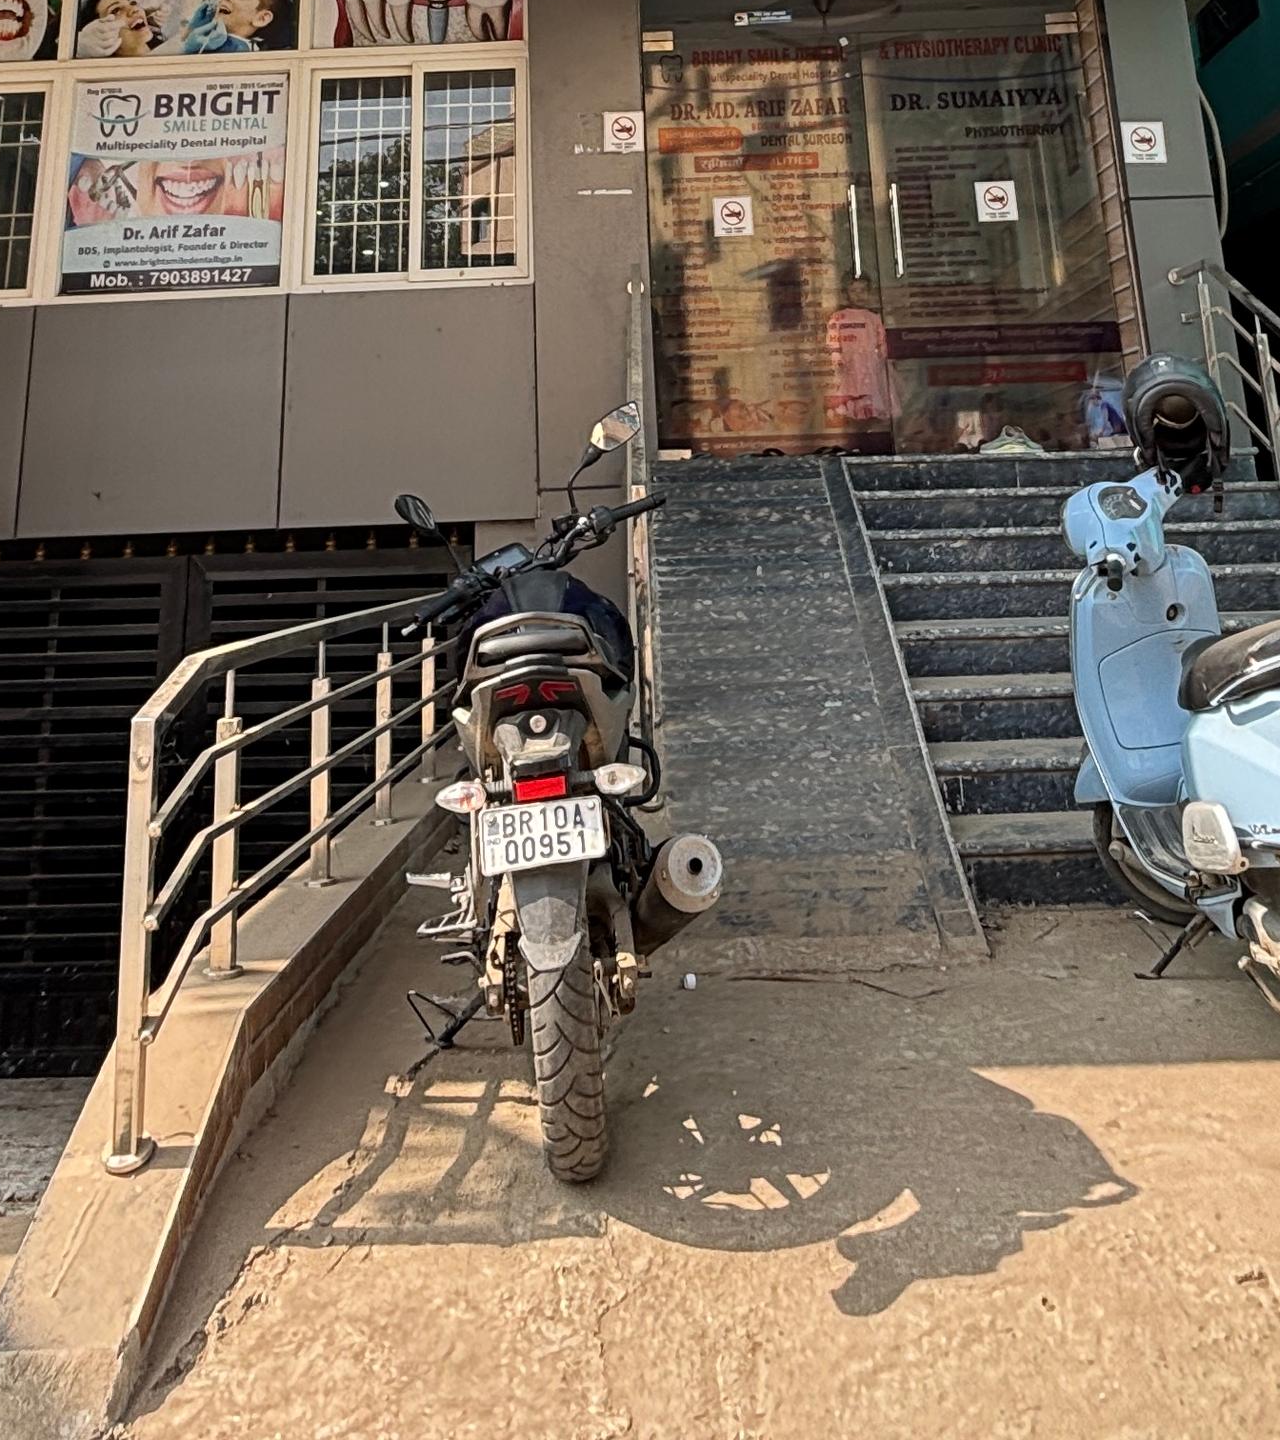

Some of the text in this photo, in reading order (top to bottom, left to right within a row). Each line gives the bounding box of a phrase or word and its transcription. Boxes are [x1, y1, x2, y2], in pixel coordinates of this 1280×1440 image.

[894, 37, 1009, 58] PHYSIOTHERAPY
[1015, 35, 1062, 54] CLINIC
[692, 49, 743, 67] BRIGHT
[747, 47, 795, 66] SMILE
[769, 69, 800, 80] Dental
[153, 90, 281, 118] BRIGHT
[671, 97, 850, 121] DR. MD. ARIF ZAFAR
[890, 88, 1062, 111] DR. SUMAIYYA
[163, 116, 268, 133] SMILE DENTAL
[95, 135, 267, 153] Multispeciality Dental Hospital
[761, 132, 853, 147] DENTAL SURGEON
[122, 224, 227, 241] Dr. Arif Zafar
[78, 246, 101, 257] BDS,
[177, 242, 218, 252] Founder
[219, 241, 227, 250] &
[229, 240, 269, 250] Director
[90, 273, 133, 288] Mob.
[149, 268, 253, 285] 7903891427
[502, 803, 585, 839] BR10A
